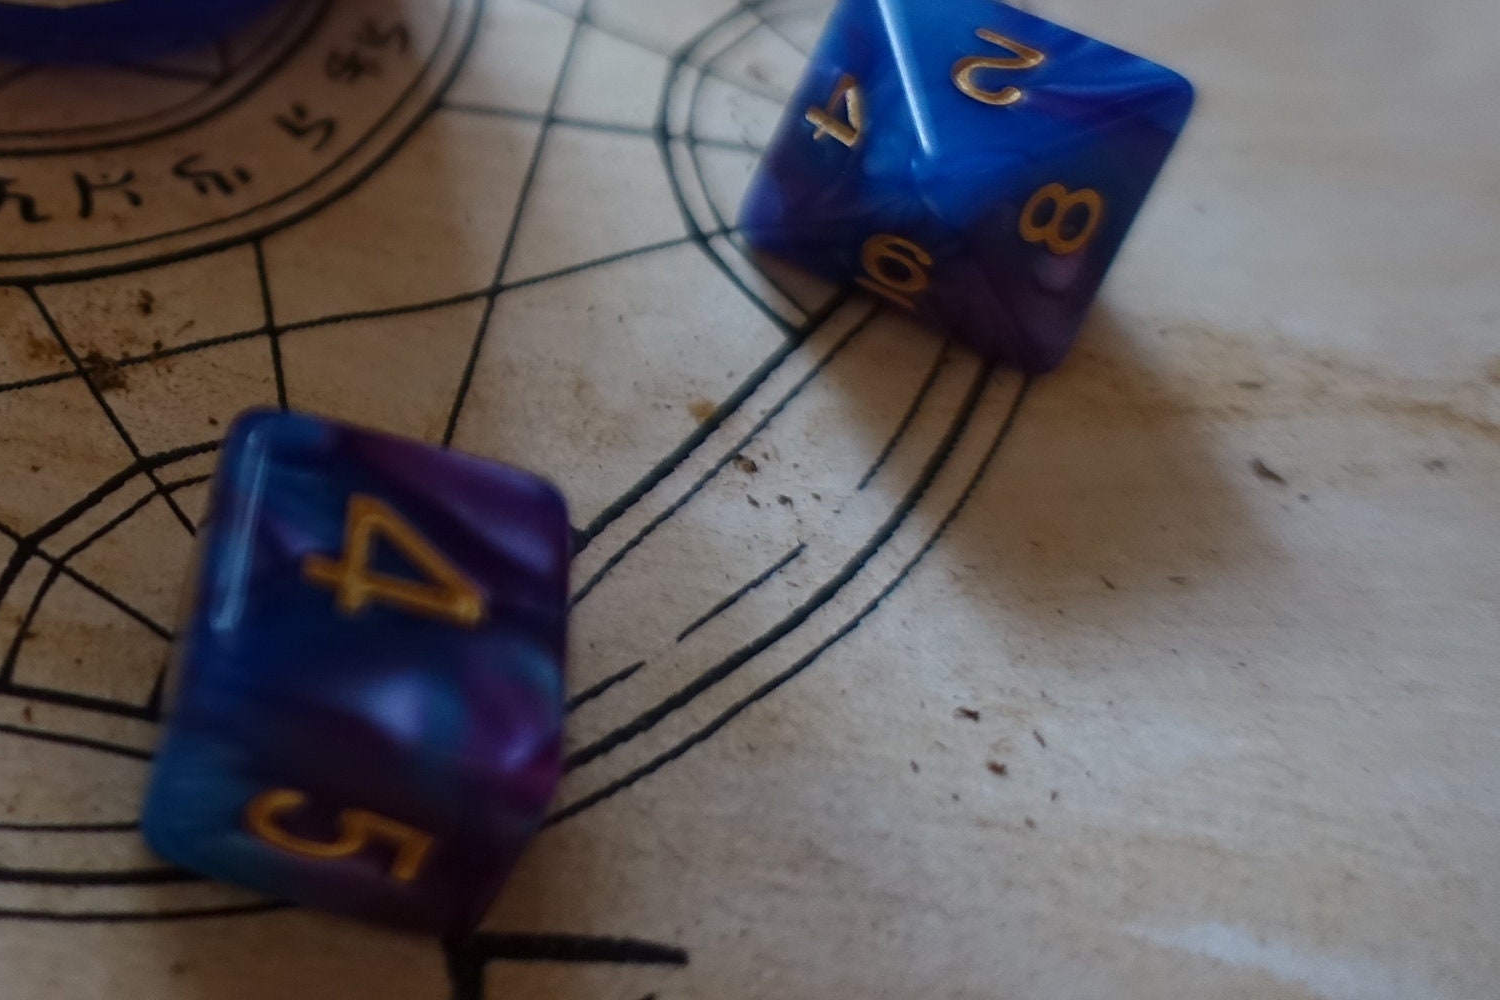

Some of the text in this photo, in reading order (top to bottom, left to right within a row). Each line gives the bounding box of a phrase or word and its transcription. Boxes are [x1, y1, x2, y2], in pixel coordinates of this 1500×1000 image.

[951, 27, 1048, 107] 2
[804, 73, 863, 148] 4
[1018, 182, 1105, 257] 8
[303, 491, 490, 628] 4
[244, 787, 435, 883] 5
